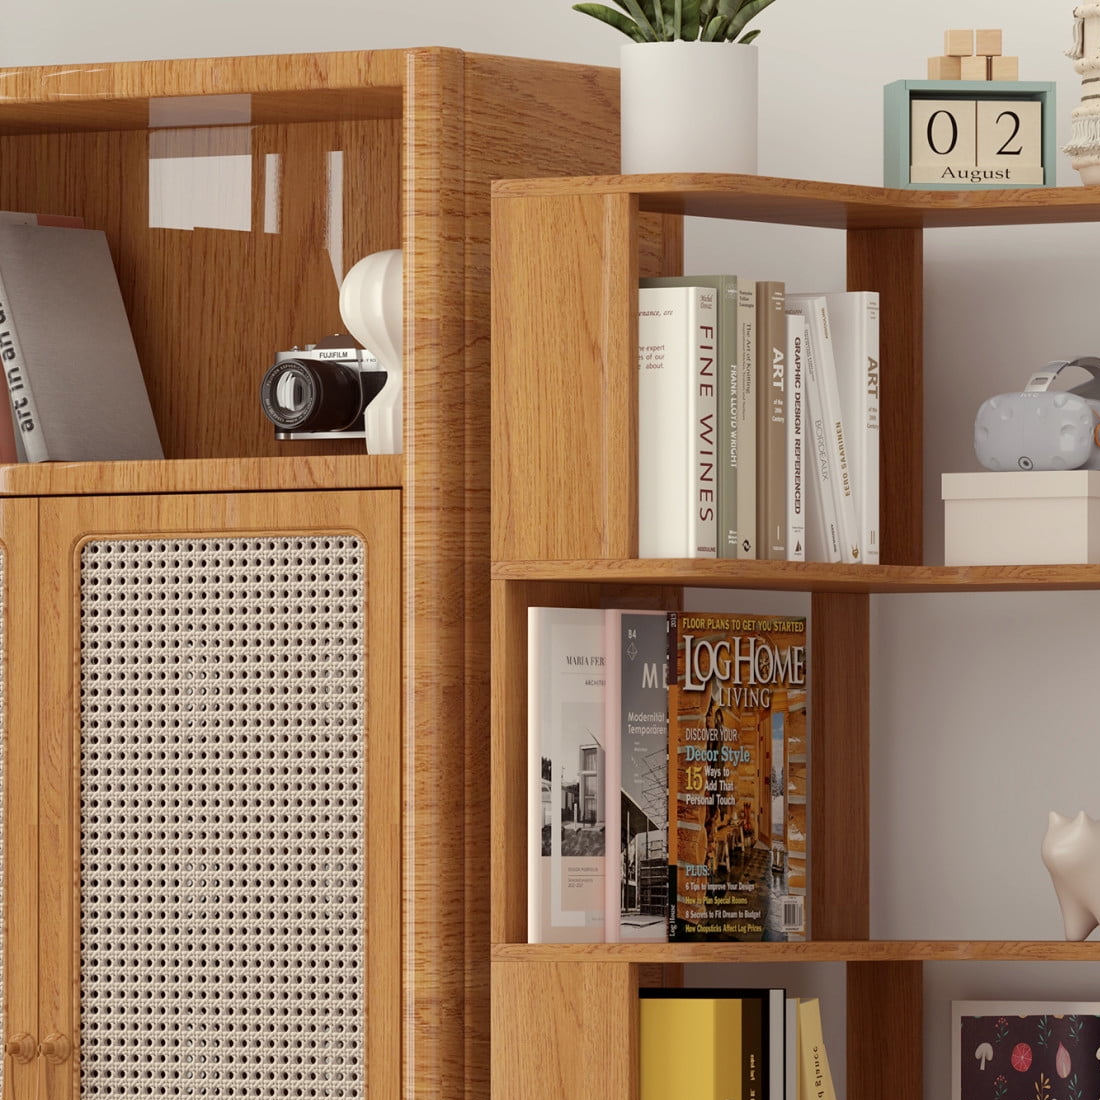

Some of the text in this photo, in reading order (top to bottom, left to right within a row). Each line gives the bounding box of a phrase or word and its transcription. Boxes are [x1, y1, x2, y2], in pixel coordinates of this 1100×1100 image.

[927, 110, 1023, 155] 0 2
[941, 166, 1011, 183] August
[319, 351, 348, 359] FUJIFILM
[699, 325, 714, 398] FINE
[8, 367, 24, 391] in
[773, 348, 784, 392] ART
[867, 356, 878, 399] ART
[15, 397, 35, 433] art
[814, 419, 829, 481] BORDEAUX
[836, 422, 851, 497] EERO SAARINEN
[699, 414, 714, 522] WINES
[683, 618, 804, 632] FLOOR PLANS TO GET YOU STARTED
[720, 687, 771, 708] LIVING
[686, 728, 738, 742] DISCOVER YOUR
[721, 745, 750, 766] Style
[685, 766, 703, 791] 15
[704, 766, 730, 778] Ways to
[705, 780, 734, 791] Add That
[686, 794, 736, 805] Personal Touch
[685, 865, 710, 877] PLUS:
[670, 925, 678, 936] Log
